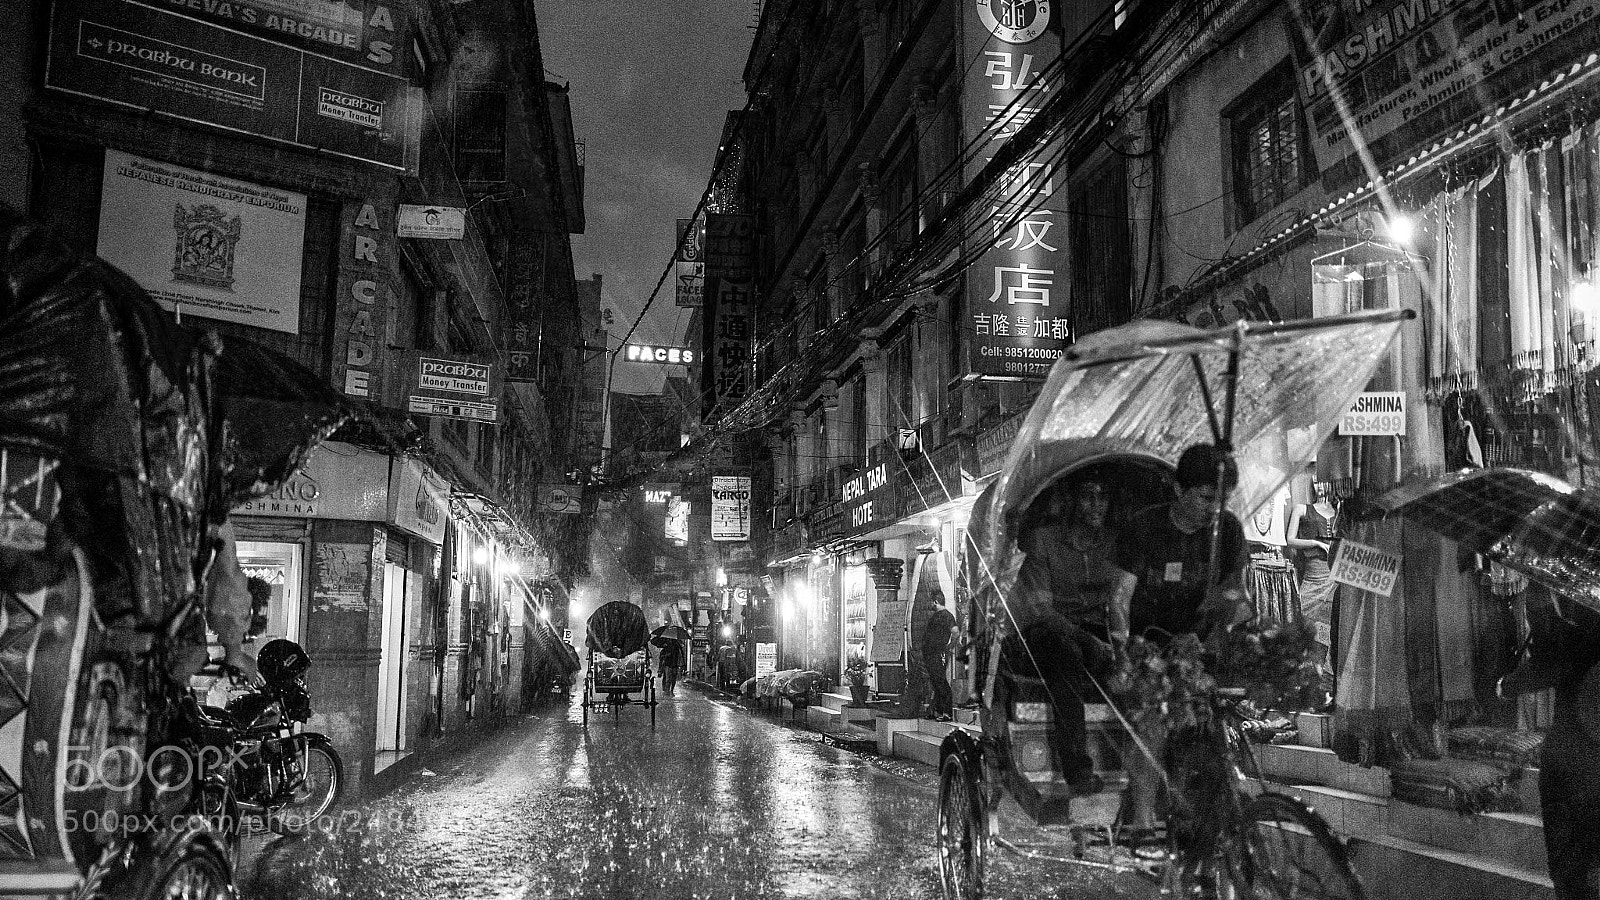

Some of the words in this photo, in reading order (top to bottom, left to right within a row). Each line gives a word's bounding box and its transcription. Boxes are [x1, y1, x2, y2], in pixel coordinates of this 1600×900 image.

[265, 14, 357, 49] ARCADE
[1516, 19, 1529, 34] &
[1402, 72, 1477, 121] Pashmina
[1482, 60, 1495, 76] &
[1500, 6, 1594, 65] Cashmere
[321, 104, 346, 117] Money
[349, 110, 380, 125] Transfer
[117, 167, 174, 188] NEPALESE
[176, 179, 245, 203] HANDICRAFT
[246, 196, 300, 215] EMPORIUM
[345, 203, 380, 397] ARCADE
[628, 345, 693, 363] FACES
[981, 346, 1002, 357] Cell:
[422, 375, 449, 388] Money
[453, 379, 487, 392] Transfer
[1344, 415, 1402, 432] RS:499
[842, 476, 866, 504] NEPAL
[867, 462, 888, 492] TARA
[1341, 544, 1397, 575] PASHMINA
[1335, 562, 1391, 592] RS:499
